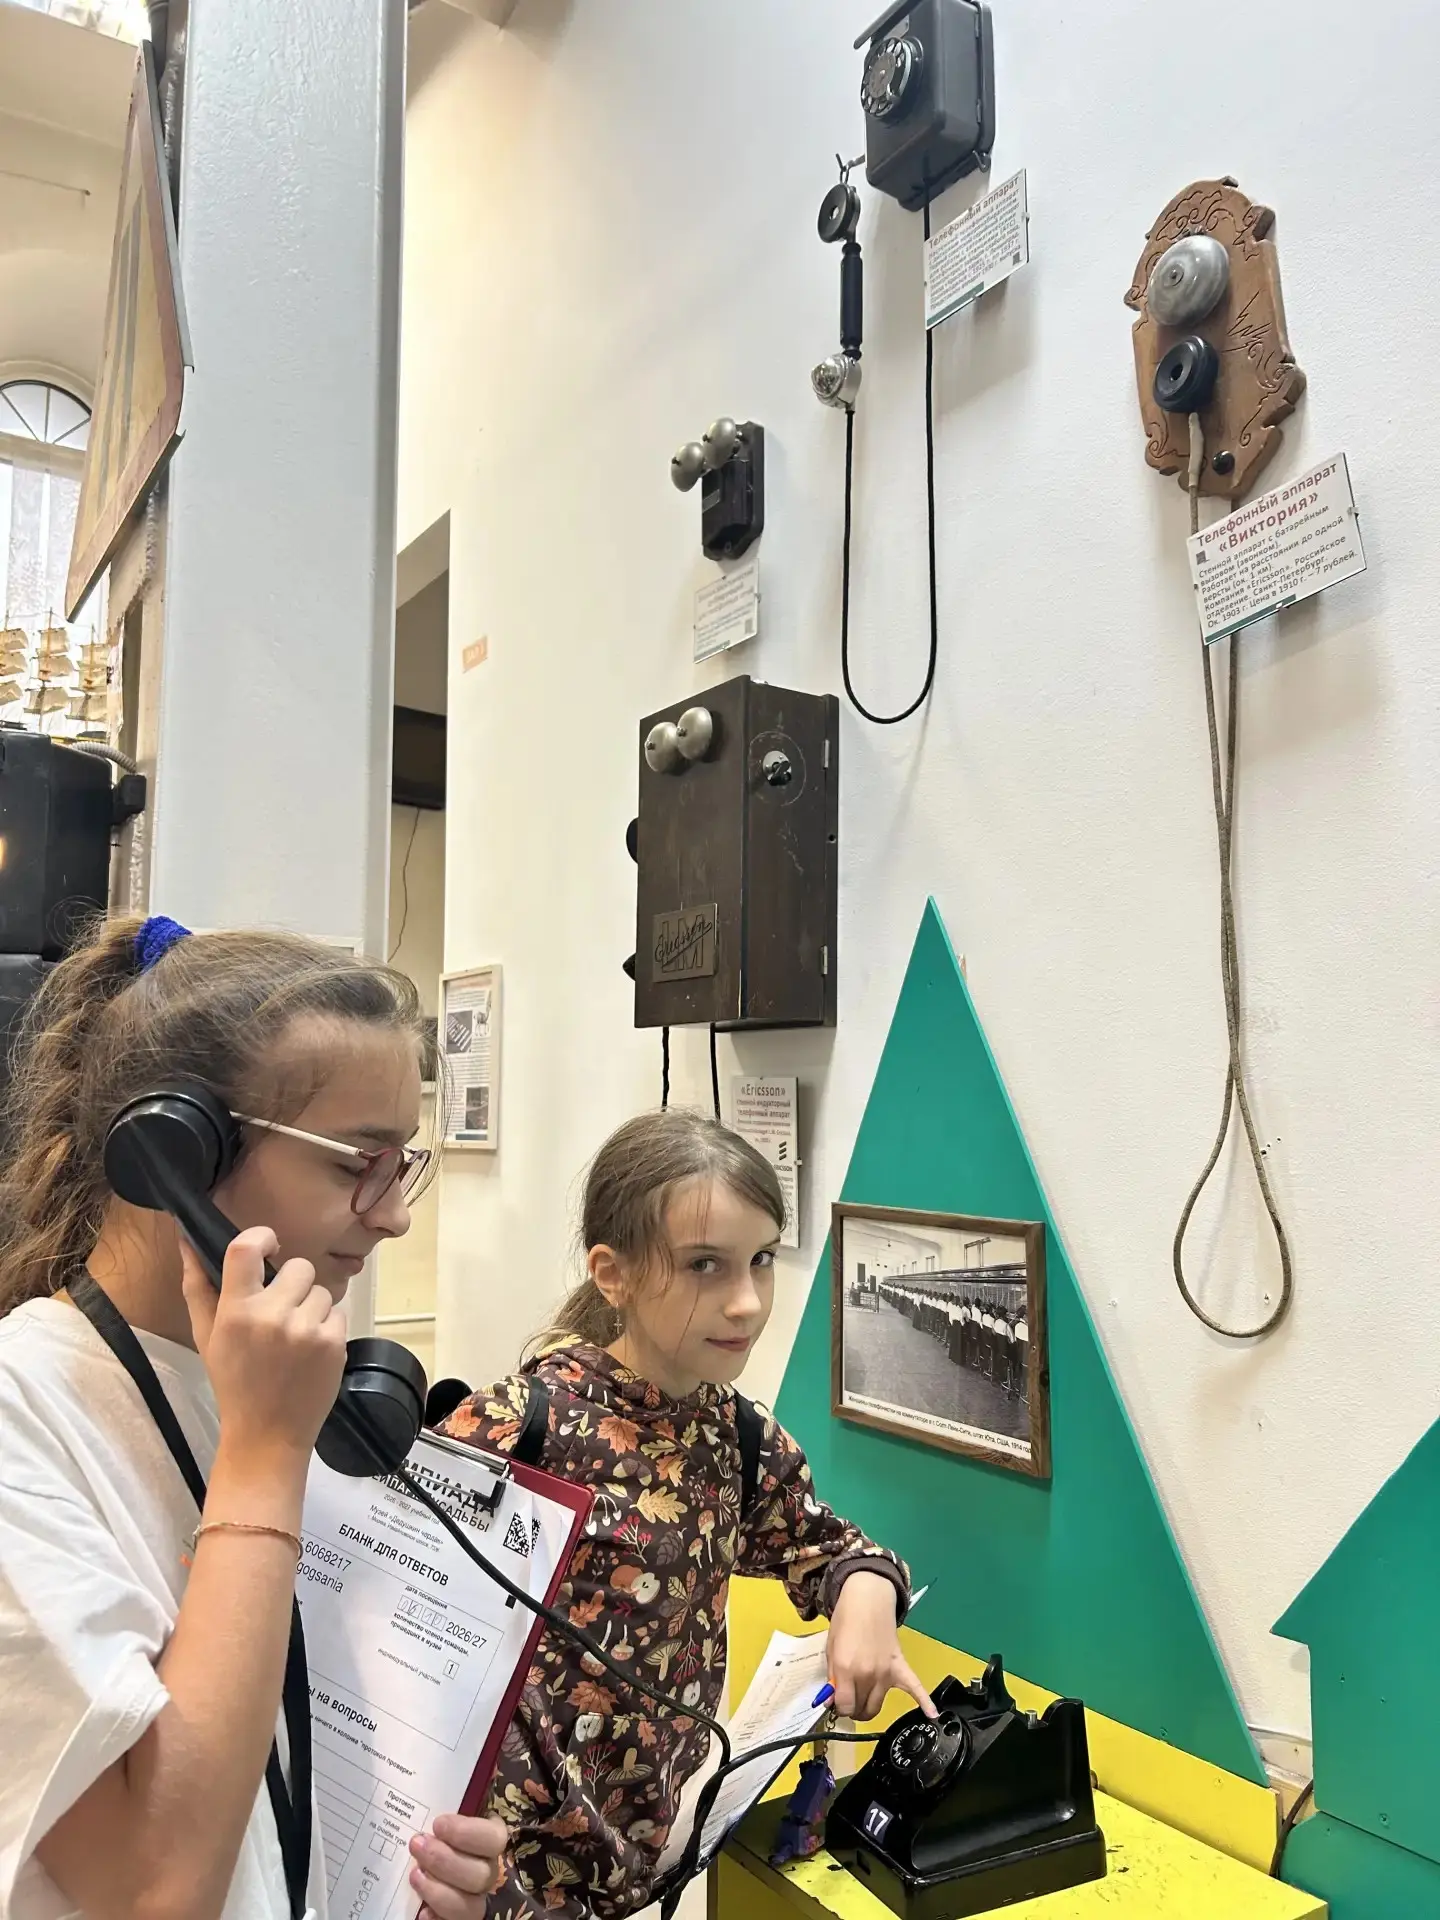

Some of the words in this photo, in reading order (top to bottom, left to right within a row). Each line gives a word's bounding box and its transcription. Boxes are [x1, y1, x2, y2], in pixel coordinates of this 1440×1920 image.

[928, 203, 981, 248] Телефонный
[983, 176, 1018, 208] аппарат
[1196, 493, 1278, 546] Телефонный
[1282, 463, 1336, 500] аппарат
[1219, 492, 1317, 551] «Виктория»
[1198, 555, 1231, 578] Стенной
[1233, 538, 1265, 560] аппарат
[1267, 534, 1273, 542] с
[1274, 505, 1328, 538] батарейным
[1201, 572, 1236, 594] Работает
[1238, 566, 1248, 575] на
[1250, 540, 1299, 570] расстоянии
[1301, 533, 1312, 544] до
[1314, 515, 1343, 536] одной
[1200, 564, 1234, 586] вызовом
[1236, 540, 1281, 568] (звонком).
[1203, 585, 1231, 603] версты
[1232, 577, 1247, 589] (ок.
[1256, 562, 1273, 575] км).
[1204, 587, 1244, 611] Компания
[1246, 565, 1292, 589] «Ericsson».
[1294, 536, 1345, 565] Российское
[1206, 594, 1250, 620] отделение.
[1252, 556, 1327, 596] Санкт-Петербург.
[1207, 619, 1220, 628] Ок.
[1222, 606, 1240, 621] 1903
[1249, 593, 1270, 607] Цена
[1278, 577, 1298, 593] 1910
[1299, 575, 1306, 583] г.
[1314, 565, 1320, 574] 7
[1322, 549, 1357, 572] рублей.
[741, 1083, 786, 1097] «Ericsson»
[402, 1459, 494, 1518] МПИАДА
[369, 1504, 388, 1517] Музей
[304, 1540, 351, 1571] 6068217
[338, 1523, 374, 1548] БЛАНК
[372, 1541, 398, 1560] ДЛЯ
[398, 1553, 448, 1585] ОТВЕТОВ
[295, 1558, 343, 1593] gogsania
[404, 1585, 418, 1594] дата
[417, 1591, 447, 1609] посещения
[390, 1620, 420, 1639] пришедших
[425, 1639, 441, 1651] музей
[393, 1612, 422, 1631] количество
[424, 1628, 443, 1642] членов
[443, 1638, 468, 1656] команды,
[445, 1621, 488, 1650] 2026/27
[447, 1663, 454, 1674] 1
[316, 1690, 330, 1704] на
[330, 1699, 377, 1731] вопросы
[314, 1715, 332, 1729] ничего
[336, 1728, 358, 1744] колонке
[359, 1739, 386, 1760] "протокол
[386, 1757, 416, 1776] проверки"
[383, 1800, 411, 1819] проверки
[387, 1790, 415, 1811] Протокол
[866, 1807, 889, 1837] 17
